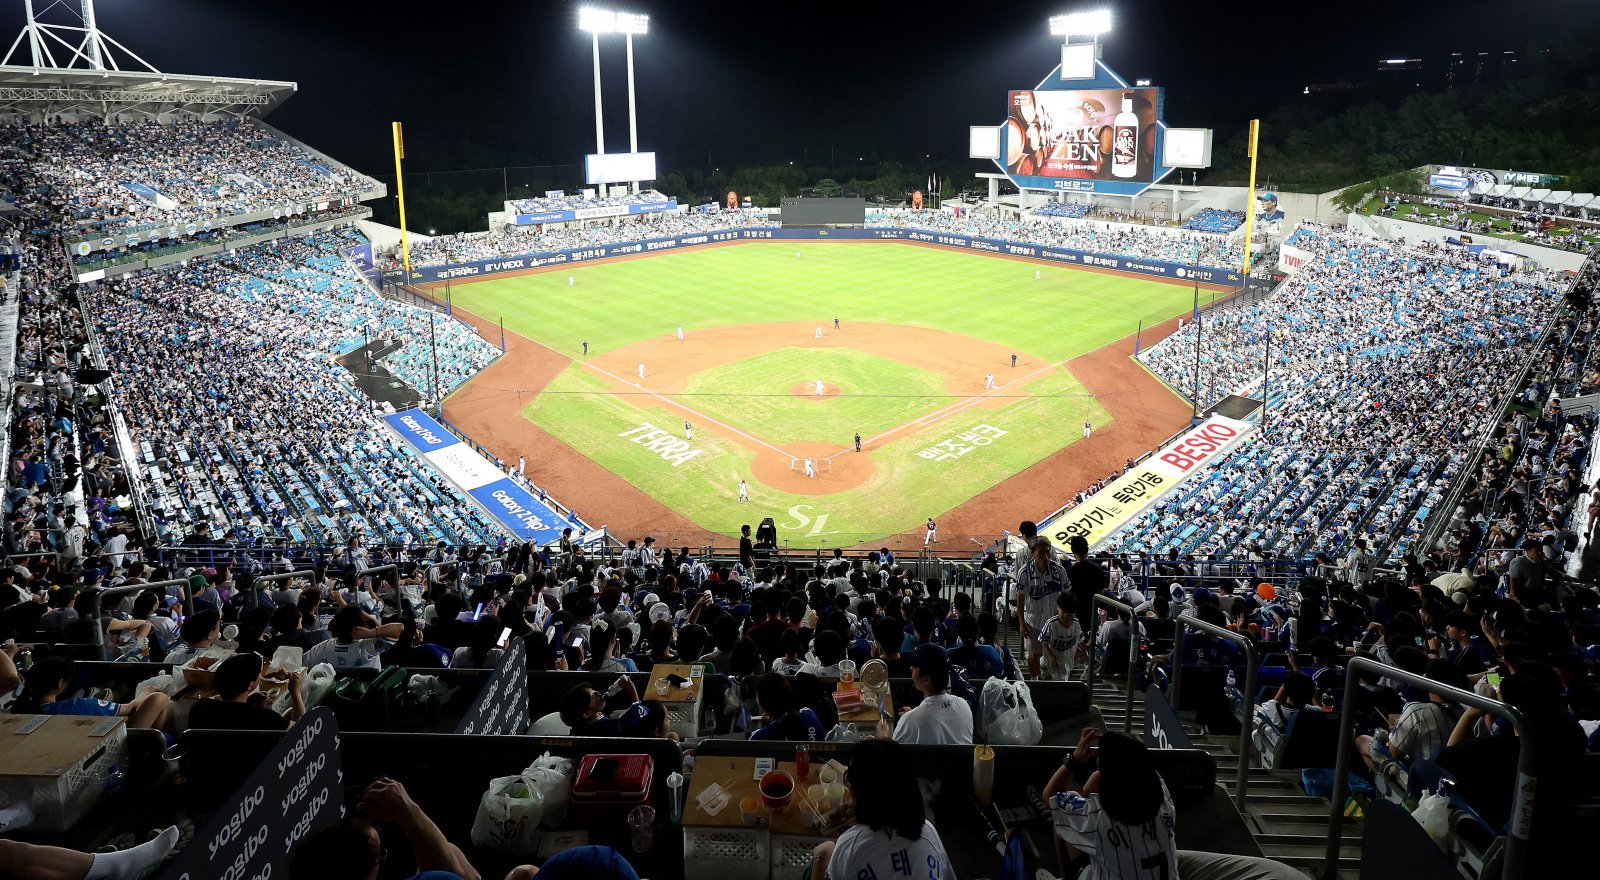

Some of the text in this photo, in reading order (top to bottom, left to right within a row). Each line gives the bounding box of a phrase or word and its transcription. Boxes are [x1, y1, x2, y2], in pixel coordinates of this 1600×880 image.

[1050, 143, 1100, 161] ZEN
[580, 209, 597, 217] HOME
[610, 207, 624, 215] ZONE
[713, 231, 738, 240] 백조씽크
[744, 230, 772, 238] 대방건설
[400, 415, 424, 432] Galaxy
[421, 431, 443, 445] Fold7
[617, 422, 704, 467] TERRA
[915, 424, 1009, 462] 백조씽크
[1160, 423, 1237, 471] BESKO
[492, 490, 551, 532] Galaxy Z Flip7
[779, 504, 839, 538] SL
[502, 644, 520, 679] yogibo
[479, 680, 499, 717] yogibo
[504, 666, 521, 701] yogibo
[505, 687, 522, 723] yogibo
[278, 717, 323, 779] yogibo
[281, 752, 326, 817] yogibo
[208, 785, 265, 861] yogibo
[284, 787, 329, 854] yogibo
[219, 824, 268, 880] ogibo
